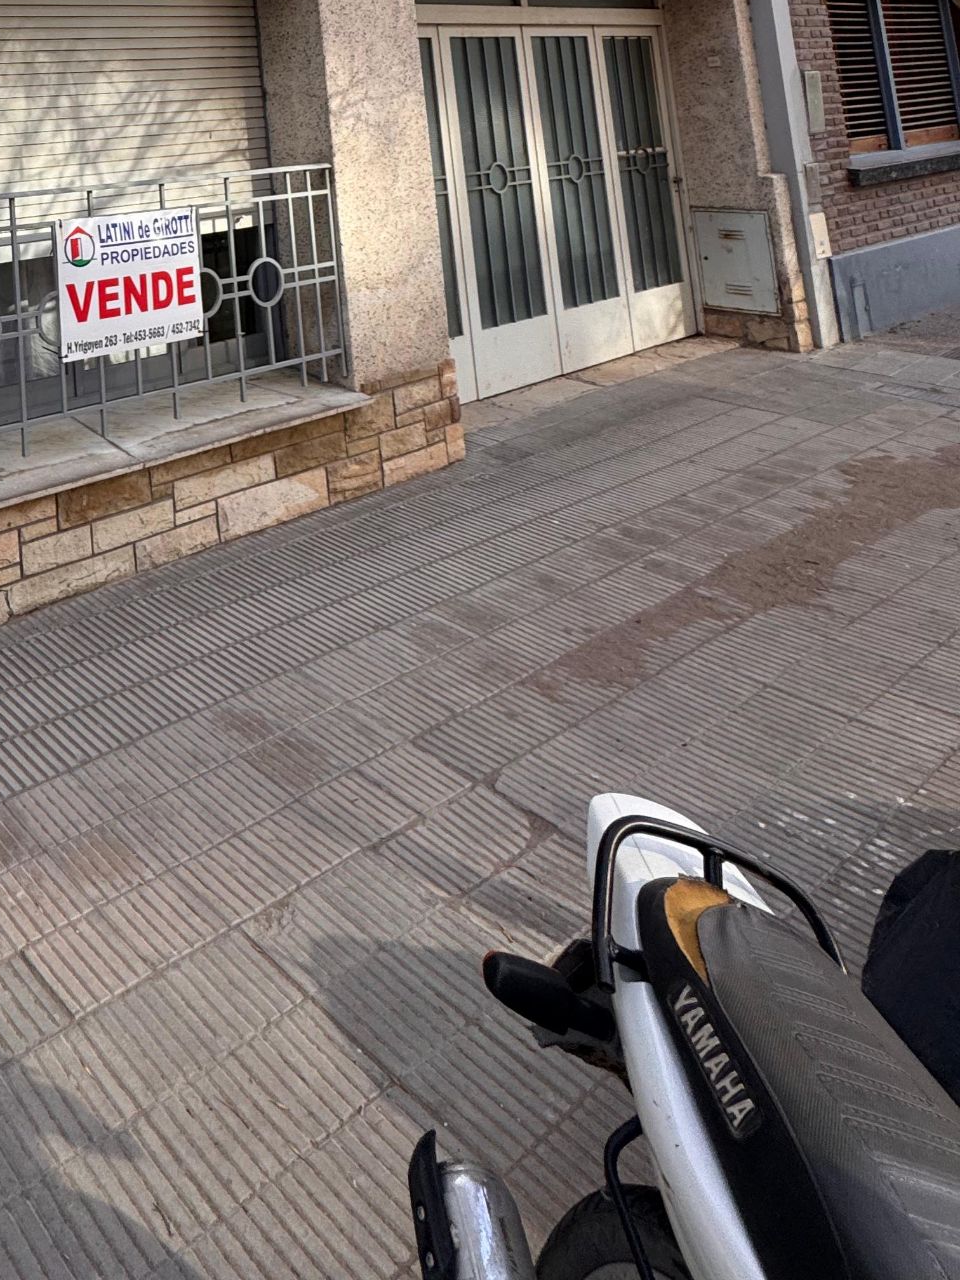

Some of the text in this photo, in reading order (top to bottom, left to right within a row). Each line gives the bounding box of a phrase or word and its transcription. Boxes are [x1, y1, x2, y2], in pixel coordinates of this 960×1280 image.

[97, 214, 194, 243] LATINI de GIROTTI
[101, 241, 195, 266] PROPIEDADES
[66, 266, 196, 323] VENDE
[104, 334, 118, 348] 263
[171, 319, 200, 335] 452-7342
[674, 984, 755, 1129] YAMAHA
